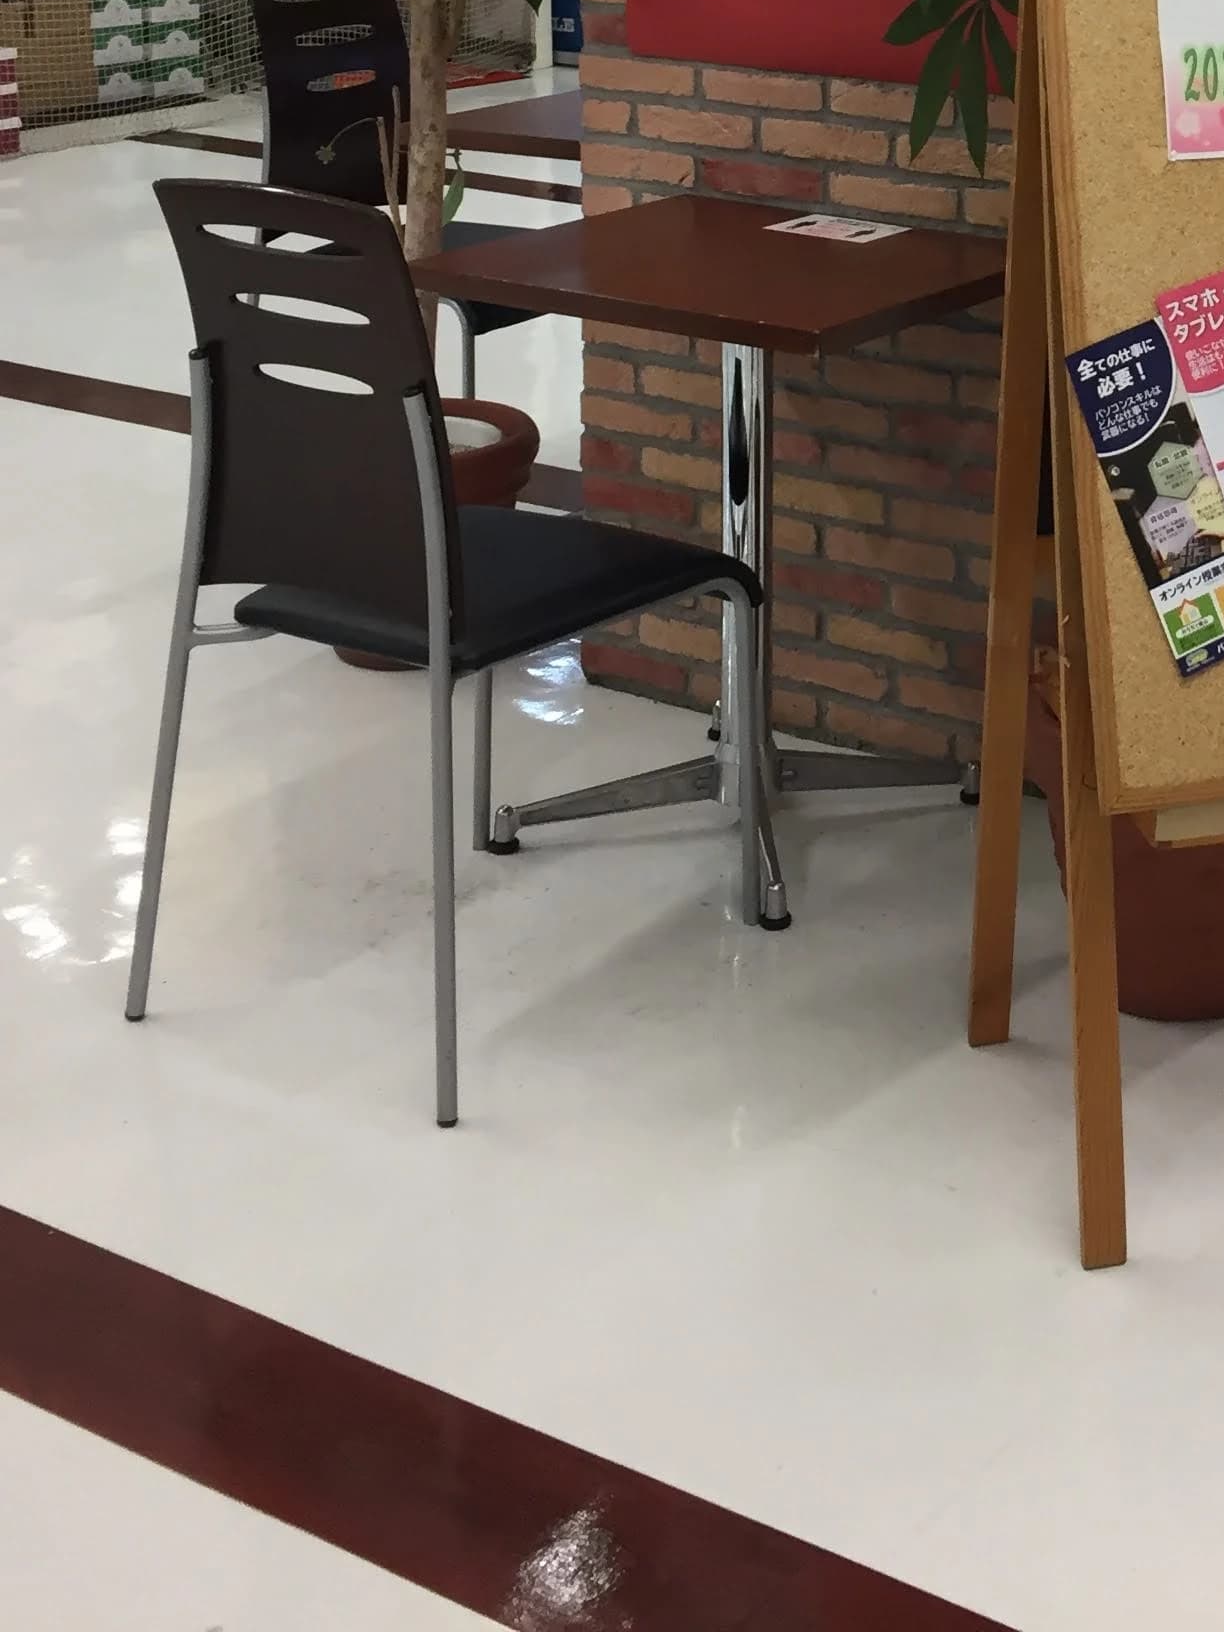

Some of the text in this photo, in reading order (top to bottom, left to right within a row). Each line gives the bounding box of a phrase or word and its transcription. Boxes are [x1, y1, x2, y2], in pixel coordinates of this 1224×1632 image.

[1077, 338, 1156, 382] 全ての仕事に
[1095, 385, 1163, 422] パソコンスキルは
[1098, 399, 1159, 431] どんな仕事でも
